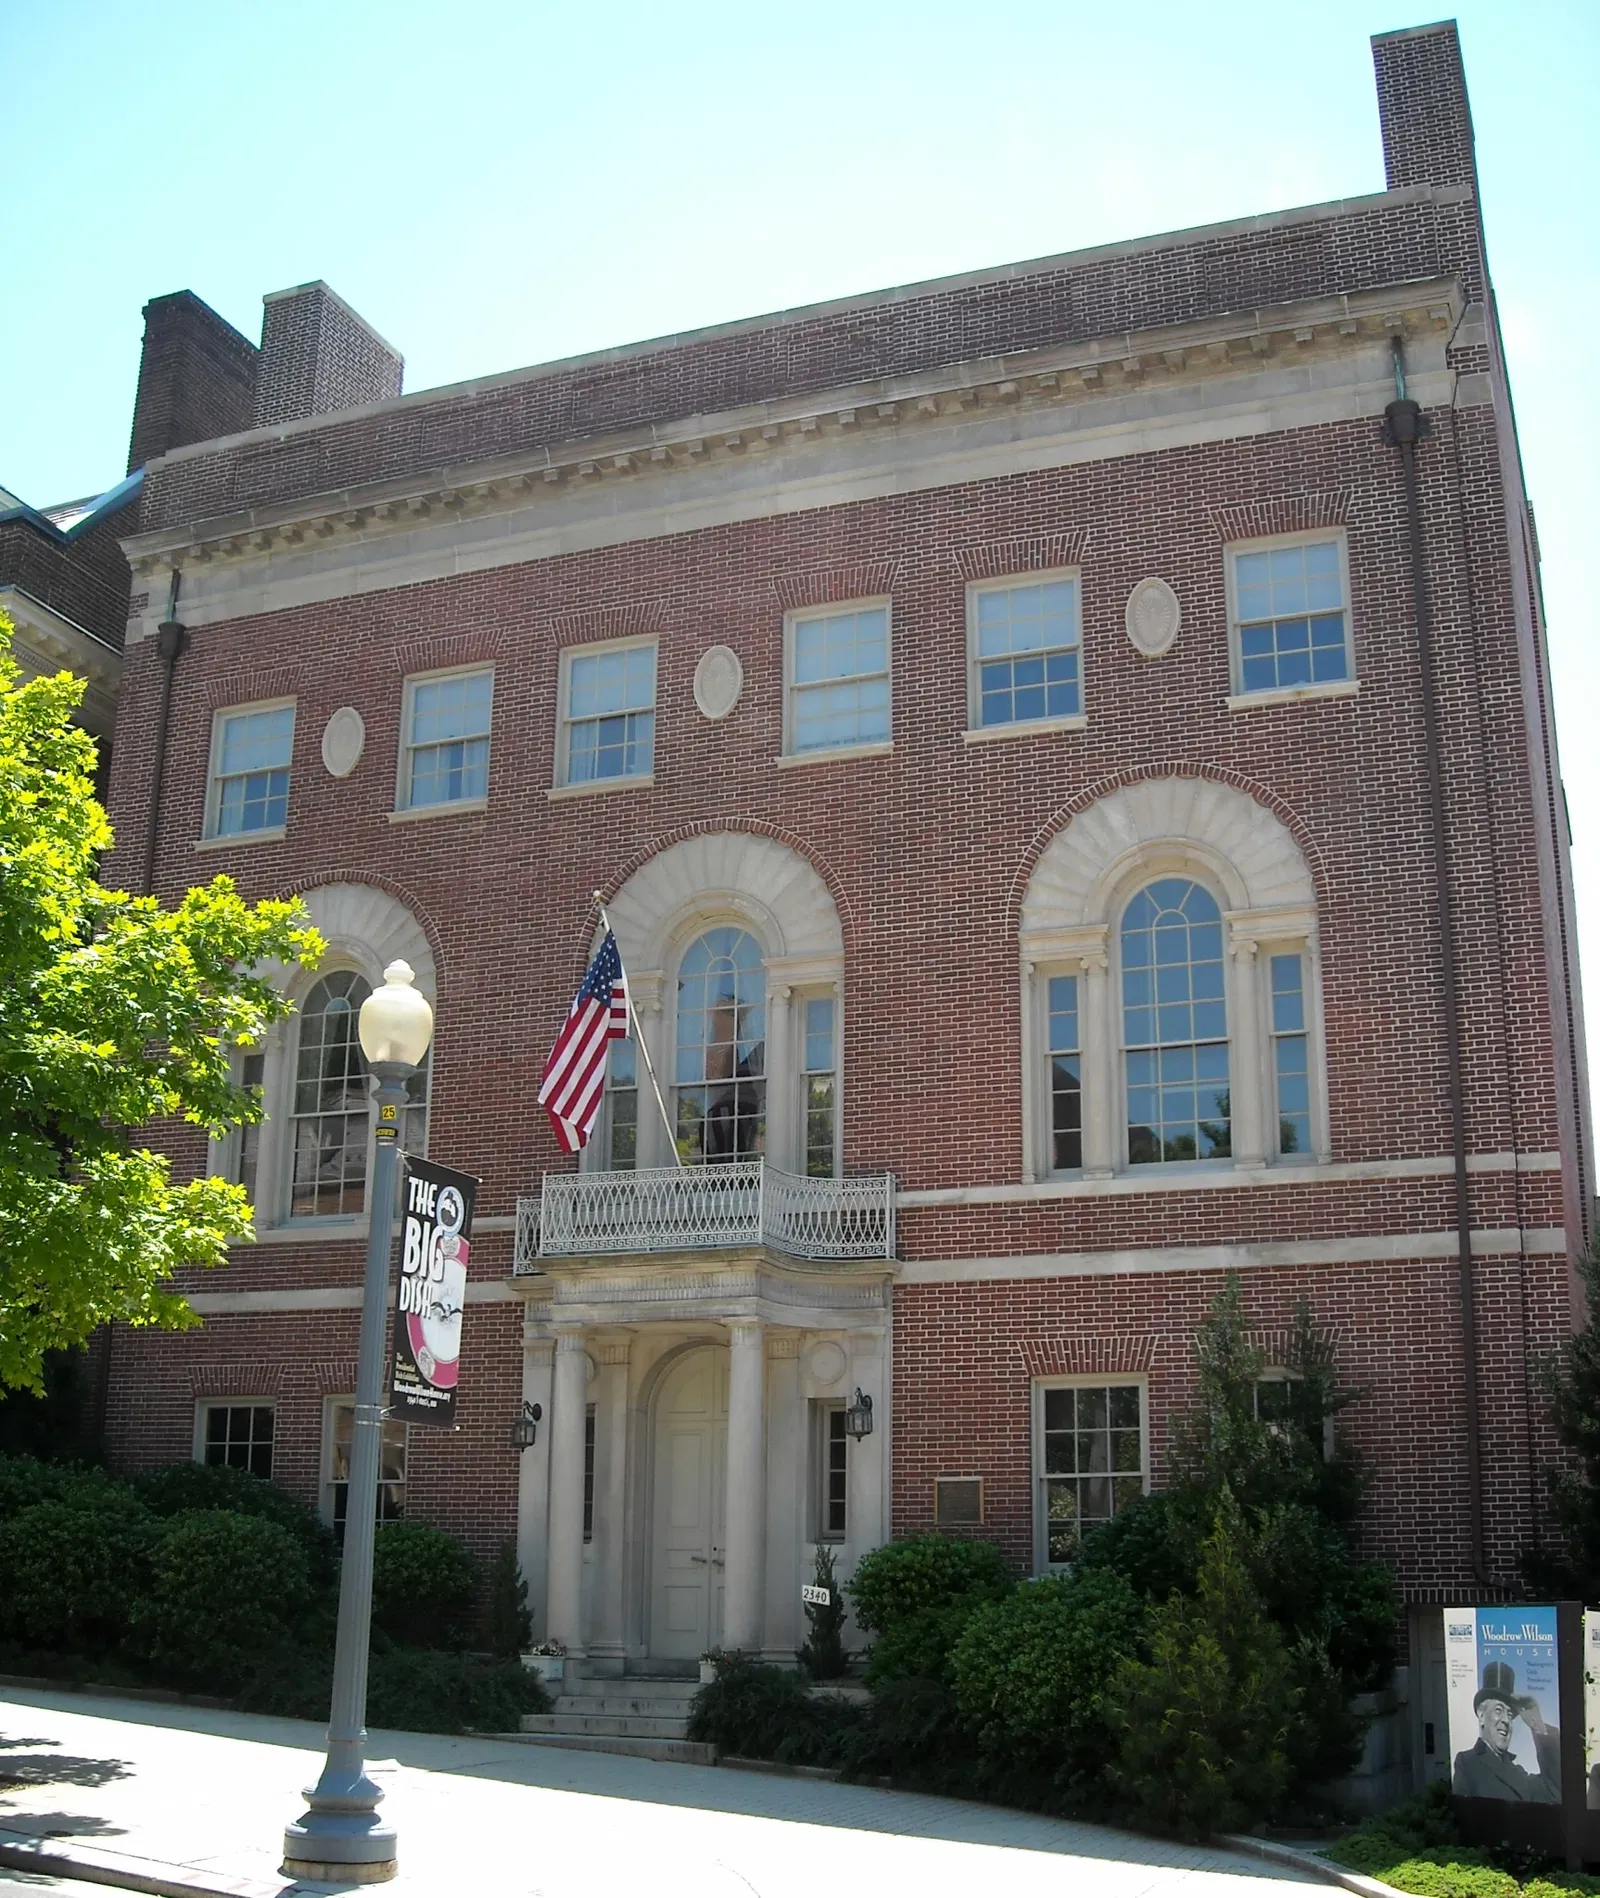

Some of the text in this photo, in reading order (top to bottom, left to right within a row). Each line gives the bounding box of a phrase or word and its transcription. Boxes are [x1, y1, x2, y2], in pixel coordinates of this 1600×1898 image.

[383, 1107, 395, 1118] 25
[408, 1176, 438, 1218] THE
[402, 1216, 445, 1282] BIG
[399, 1275, 432, 1319] DISH
[803, 1588, 827, 1603] 2340
[1481, 1624, 1553, 1641] Woodrow Wilson
[1484, 1647, 1553, 1657] HOUSE
